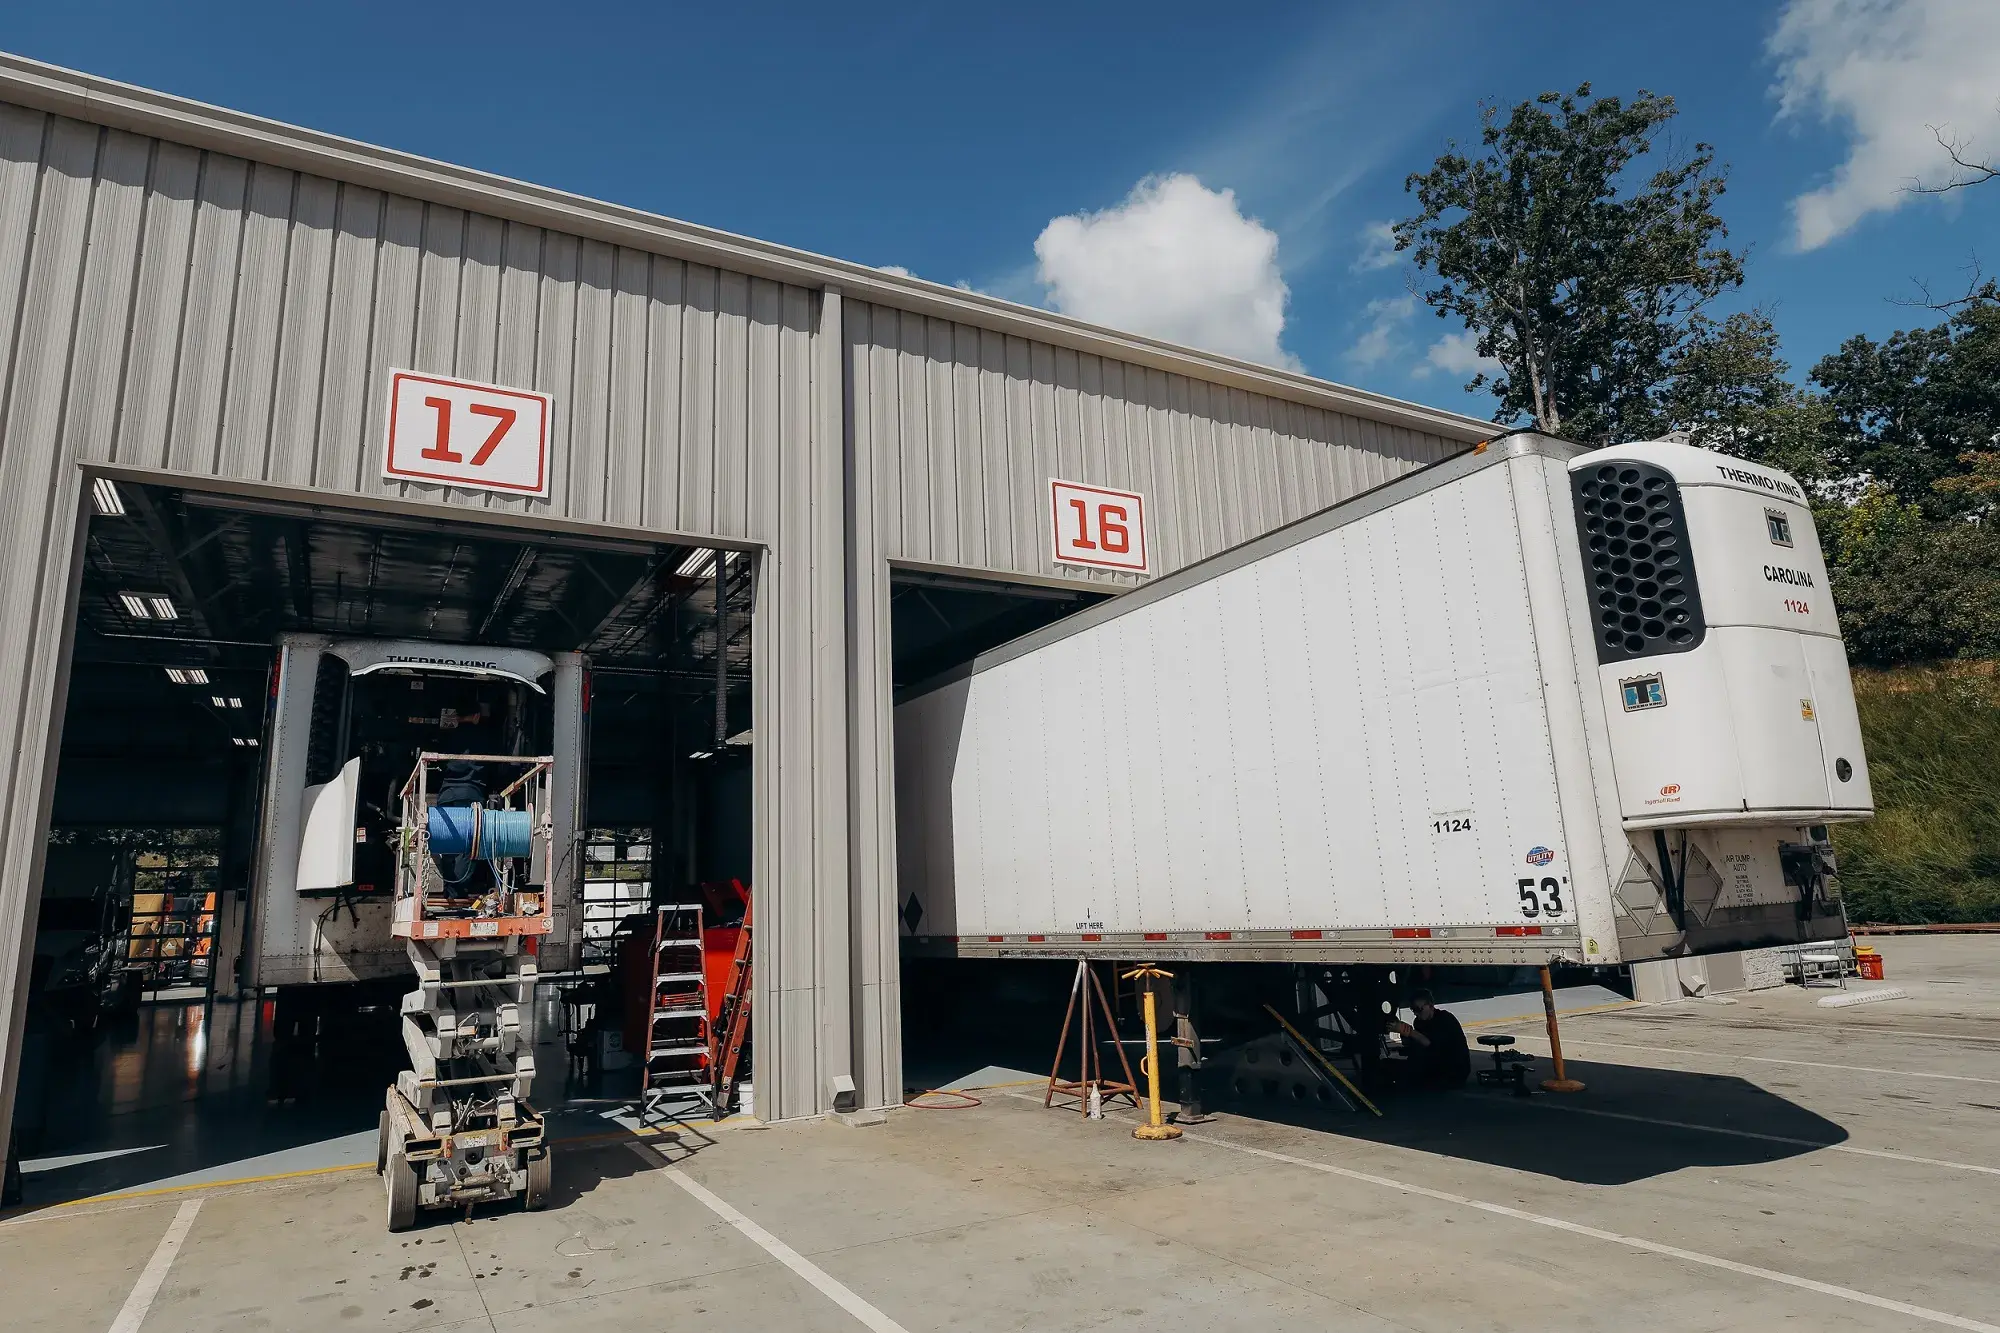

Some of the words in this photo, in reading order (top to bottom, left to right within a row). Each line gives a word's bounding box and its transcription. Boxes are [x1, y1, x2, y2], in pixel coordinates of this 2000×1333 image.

[421, 396, 517, 466] 17
[1716, 465, 1774, 490] THERMO
[1773, 480, 1801, 499] KING
[1070, 499, 1129, 554] 16
[1763, 565, 1815, 588] CAROLINA
[1784, 599, 1809, 614] 1124
[460, 660, 497, 669] KING
[1433, 819, 1472, 833] 1124
[1527, 851, 1553, 863] UTILITY
[1725, 854, 1735, 863] AIR
[1735, 854, 1750, 862] DUMP
[1733, 863, 1747, 872] AUTO
[1075, 922, 1088, 930] LIFT
[1088, 922, 1104, 930] HERE
